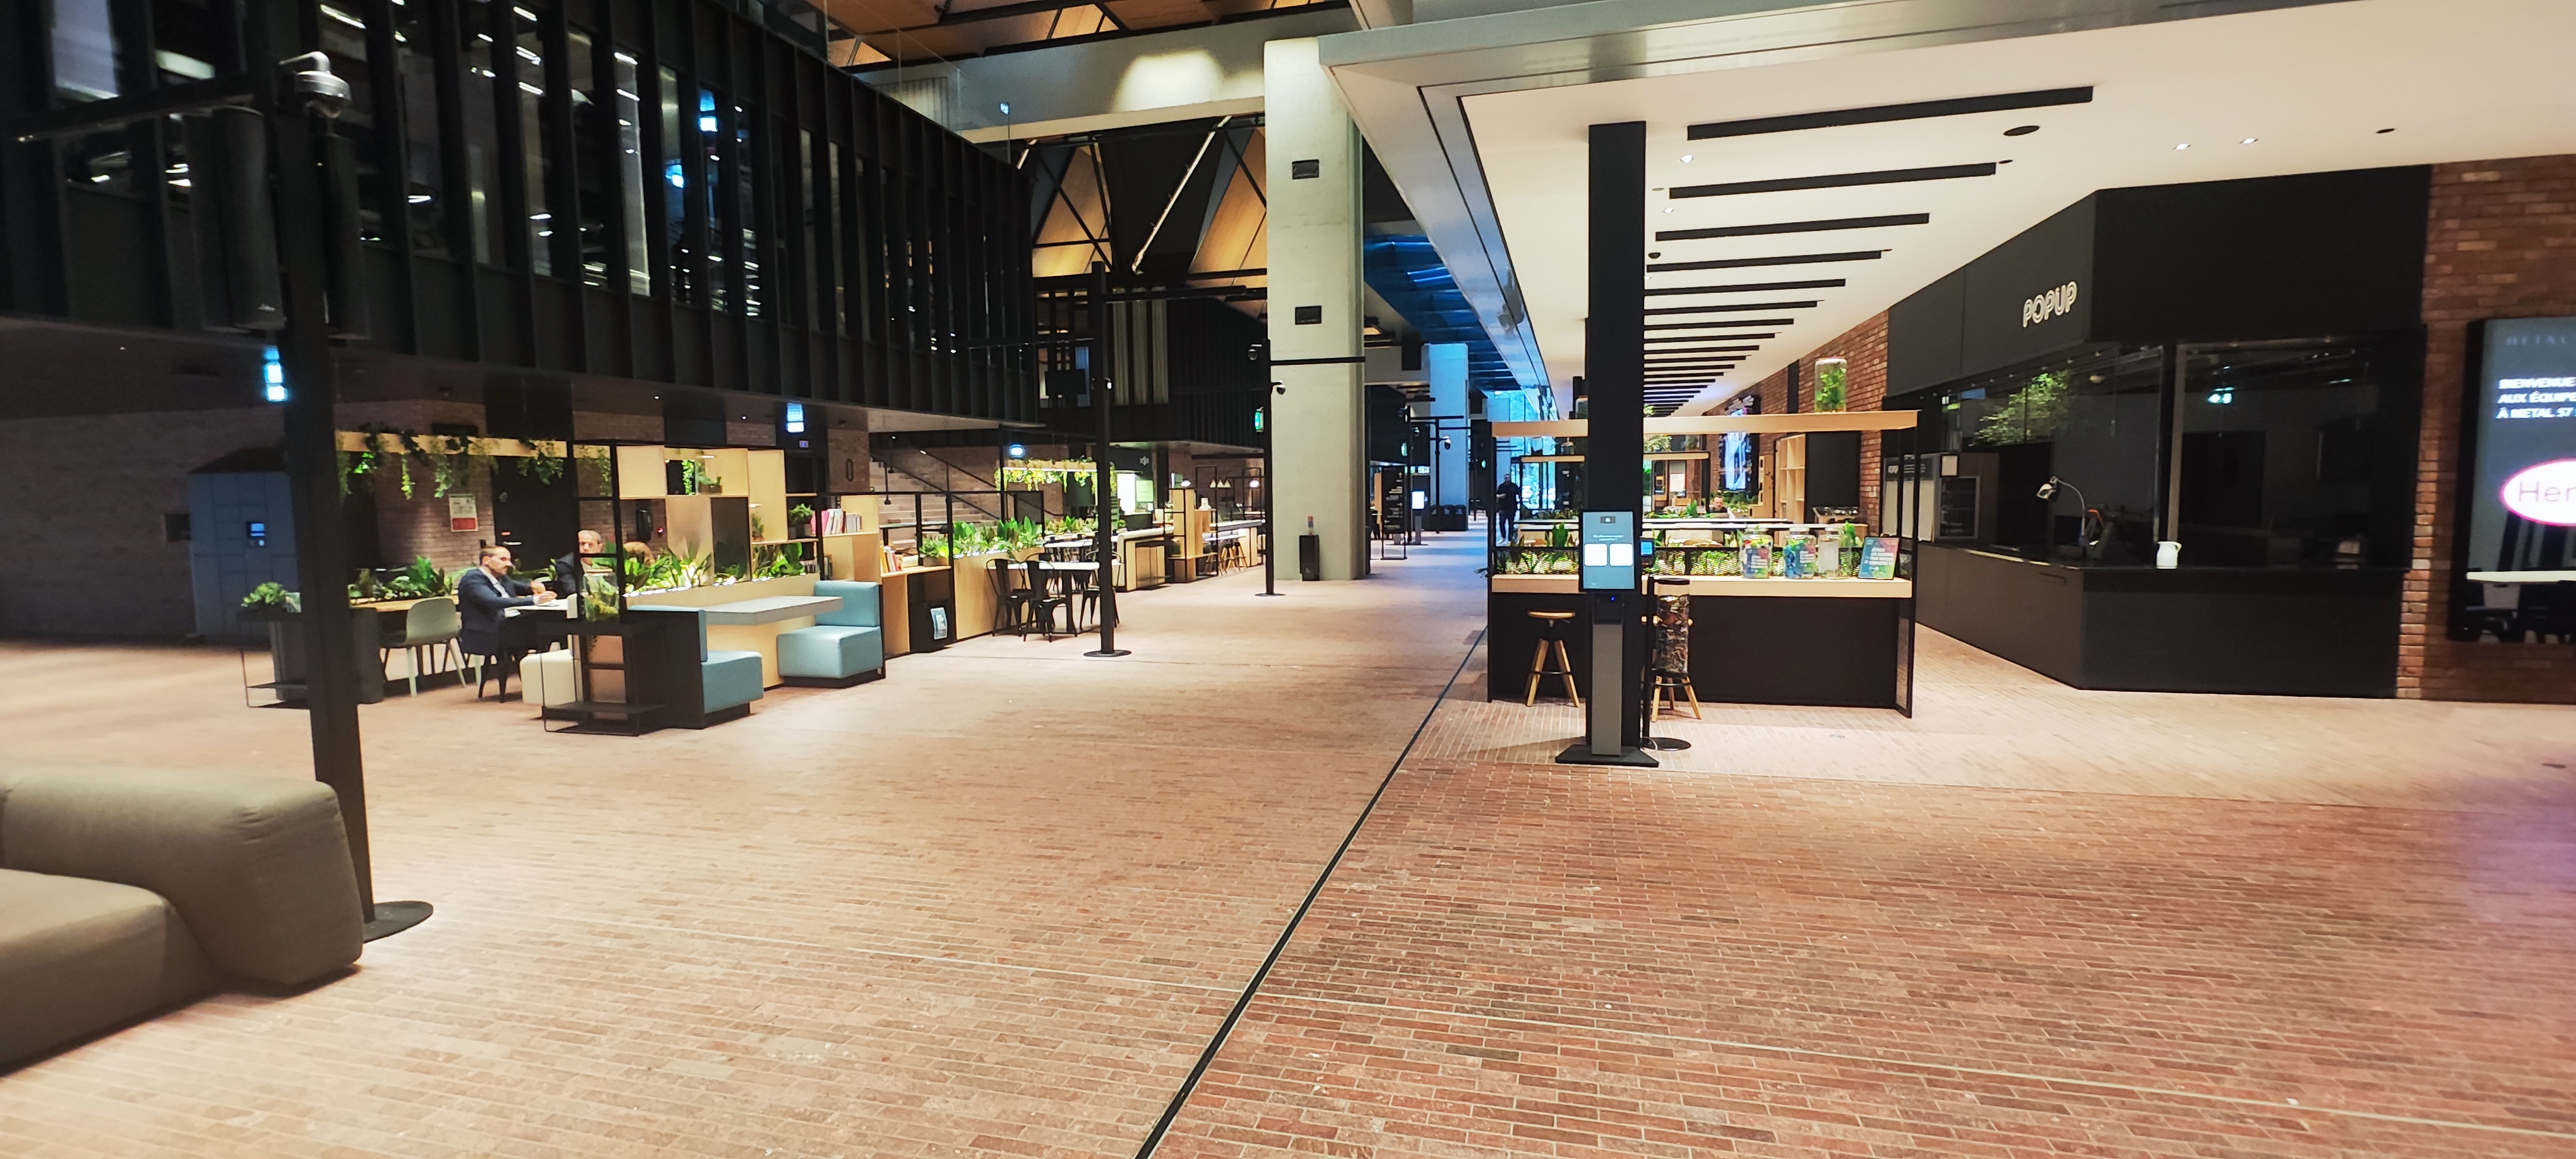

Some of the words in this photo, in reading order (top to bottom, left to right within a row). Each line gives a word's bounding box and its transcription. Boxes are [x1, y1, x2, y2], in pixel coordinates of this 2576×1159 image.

[2022, 280, 2077, 328] POPUP
[2498, 377, 2576, 389] BIENVENUE
[2497, 393, 2527, 404] AUX
[2496, 407, 2509, 419] À
[2510, 408, 2555, 419] METAL
[2556, 407, 2574, 418] 57
